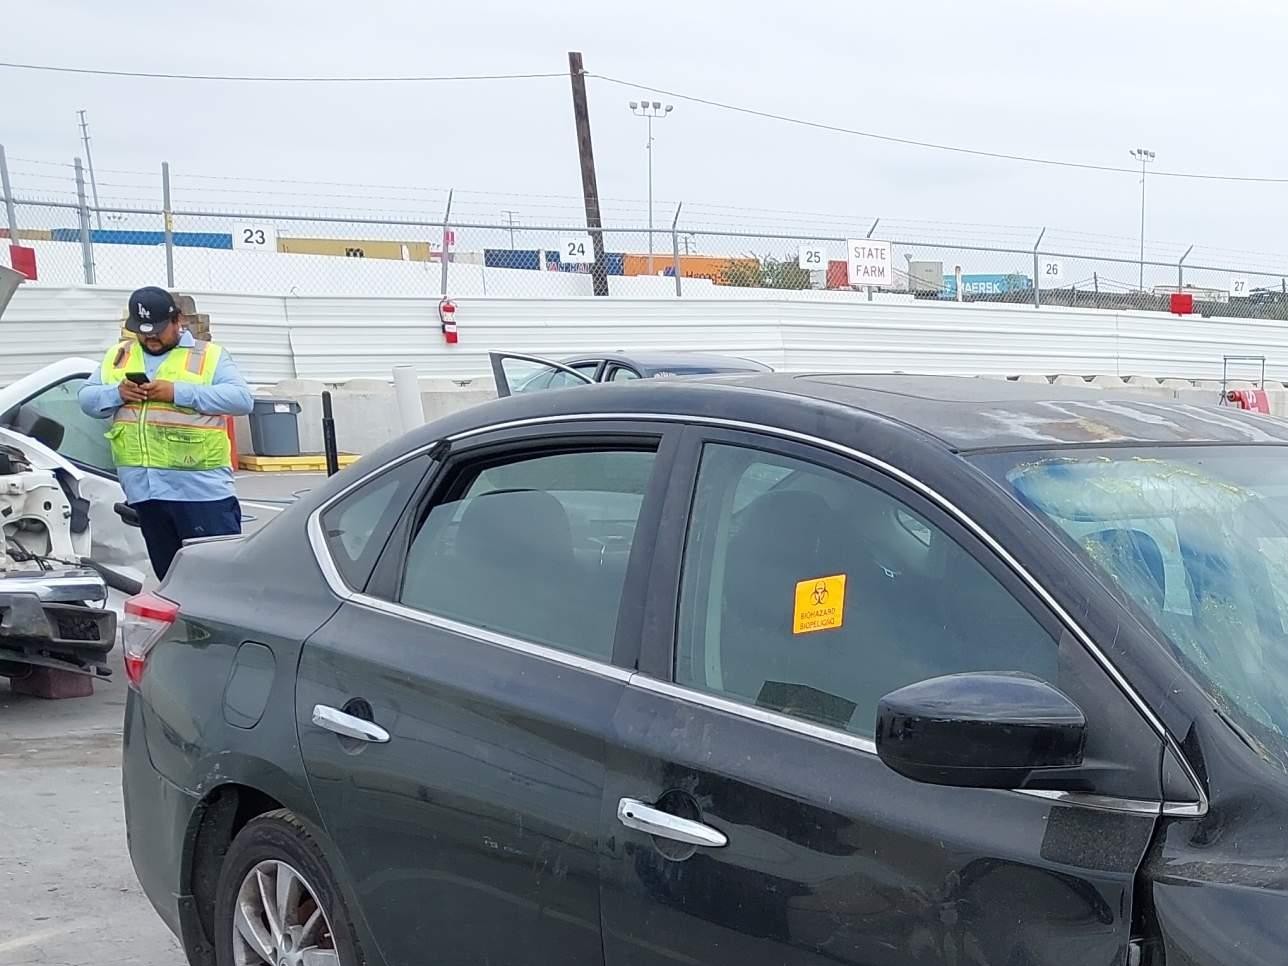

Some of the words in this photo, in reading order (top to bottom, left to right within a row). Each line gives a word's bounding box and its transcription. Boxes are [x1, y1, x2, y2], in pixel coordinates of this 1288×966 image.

[243, 229, 266, 245] 23
[567, 242, 586, 256] 24
[854, 246, 886, 260] STATE
[806, 250, 821, 264] 25
[856, 265, 885, 278] FARM
[1046, 263, 1058, 275] 26
[1234, 281, 1245, 292] 27
[137, 302, 151, 319] LA
[800, 607, 836, 620] BIOHAZARD
